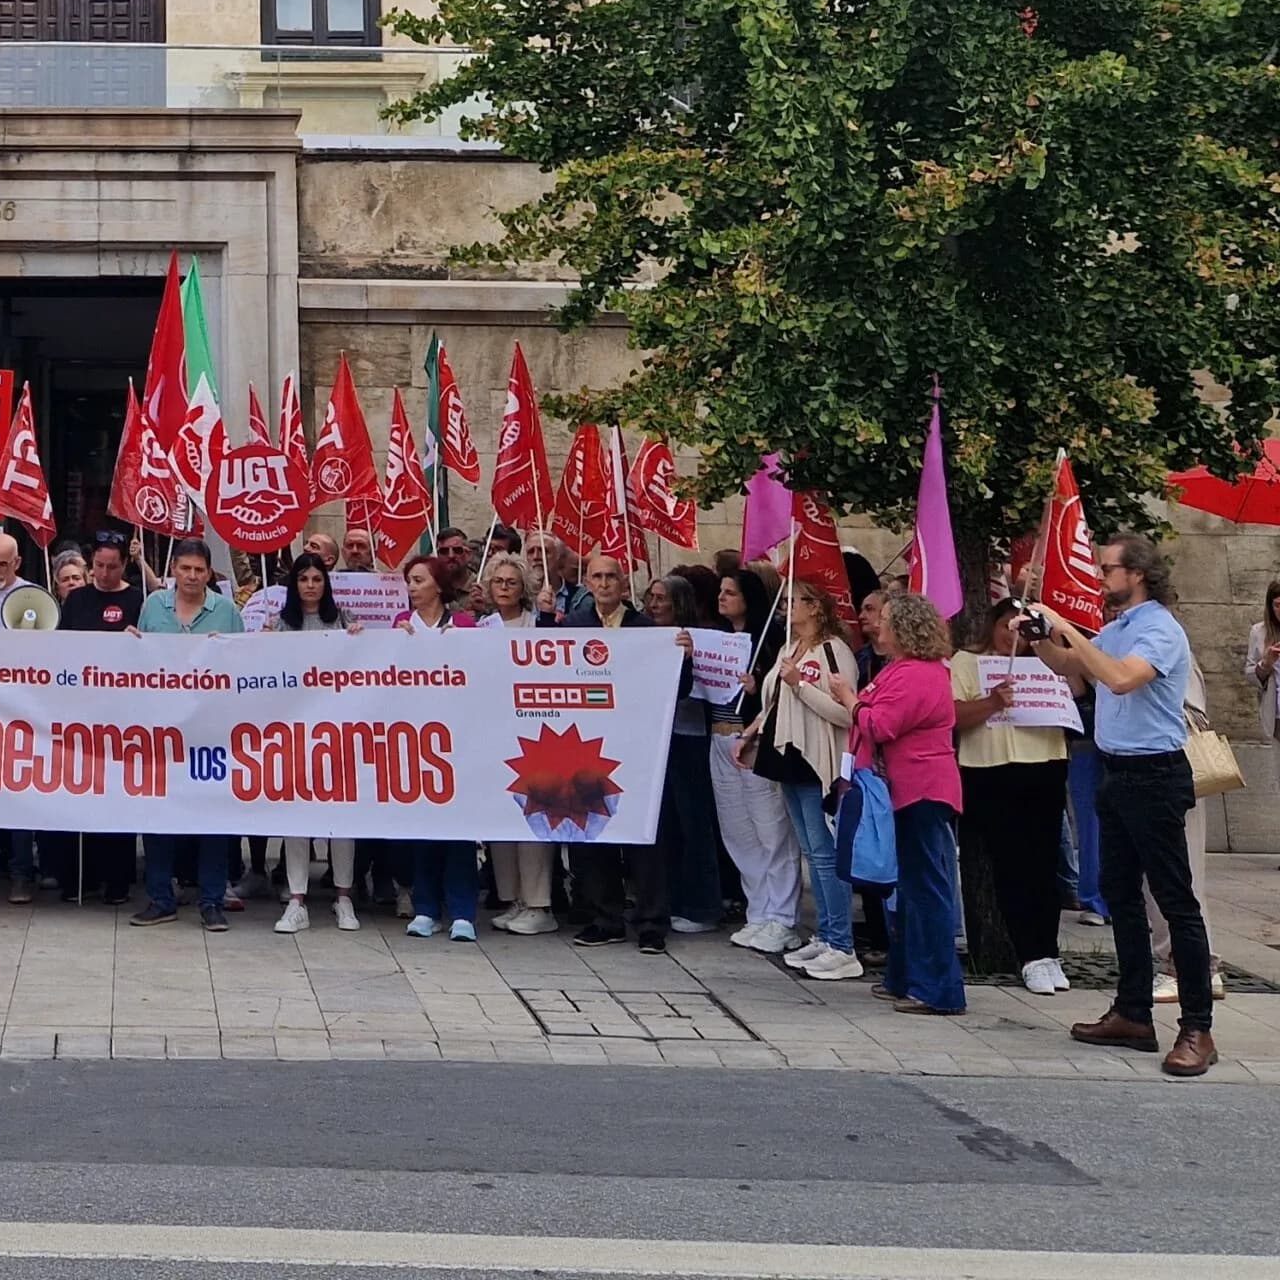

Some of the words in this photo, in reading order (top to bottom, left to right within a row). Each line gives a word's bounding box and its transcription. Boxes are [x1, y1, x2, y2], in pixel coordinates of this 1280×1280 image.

[220, 456, 288, 499] UGT
[511, 639, 576, 666] UGT
[56, 669, 78, 687] de
[81, 666, 231, 690] financiación
[236, 673, 278, 694] para
[283, 671, 298, 689] la
[302, 664, 466, 693] dependencia
[576, 668, 612, 677] Granada
[800, 665, 820, 679] UGT
[518, 688, 583, 704] CCOO
[516, 709, 561, 718] Granada
